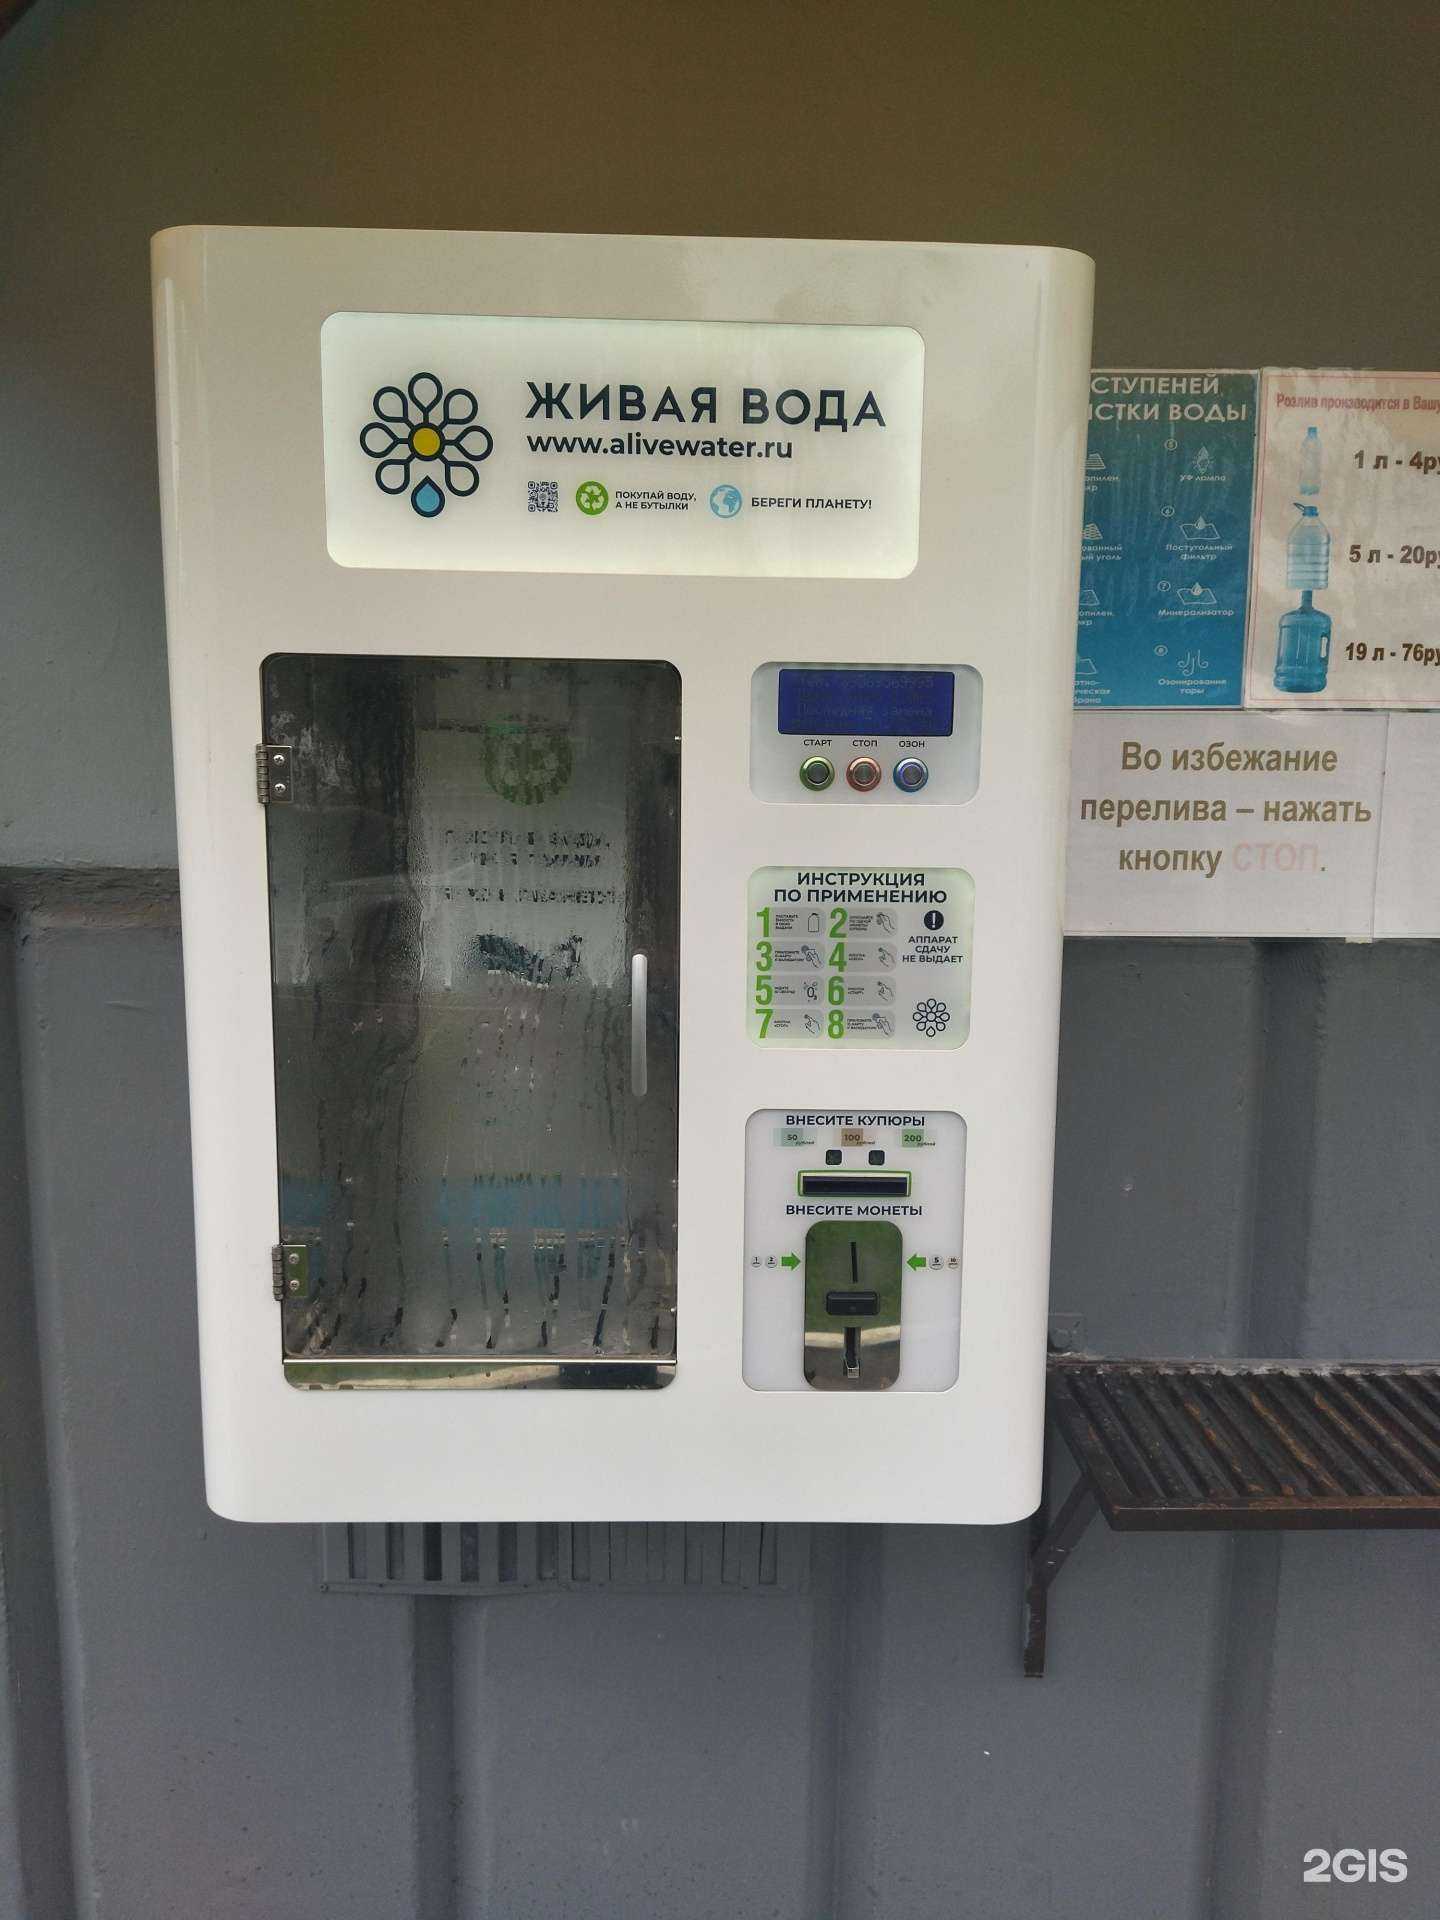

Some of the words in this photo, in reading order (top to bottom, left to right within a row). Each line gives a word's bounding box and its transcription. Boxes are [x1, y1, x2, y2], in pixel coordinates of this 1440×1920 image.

[525, 381, 717, 424] ЖИВАЯ
[742, 387, 886, 432] ВОДА
[1168, 403, 1247, 423] ВОДЫ
[526, 432, 793, 459] www.alivewater.ru
[1354, 449, 1365, 469] 1
[1373, 455, 1388, 469] л
[615, 490, 664, 501] ПОКУПАЙ
[667, 491, 697, 502] ВОДУ,
[615, 501, 623, 509] А
[625, 501, 639, 509] НЕ
[641, 501, 689, 510] БУТЫЛКИ
[751, 496, 801, 508] БЕРЕГИ
[805, 498, 872, 510] ПЛАНЕТУ!
[1349, 544, 1361, 563] 5
[1368, 549, 1381, 563] л
[1346, 642, 1368, 661] 19
[1372, 647, 1385, 661] л
[803, 739, 833, 747] СТАРТ
[852, 739, 878, 748] СТОП
[899, 740, 925, 748] ОЗОН
[1121, 741, 1162, 771] Во
[1172, 741, 1338, 772] избежание
[1081, 798, 1227, 827] перелива
[1263, 800, 1373, 823] нажать
[1119, 848, 1222, 879] кнопку
[798, 871, 925, 888] ИНСТРУКЦИЯ
[774, 889, 802, 902] ПО
[807, 890, 947, 904] ПРИМЕНЕНИЮ
[756, 907, 770, 938] 1
[829, 907, 848, 938] 2
[908, 935, 958, 944] АППАРАТ
[756, 941, 773, 972] 3
[828, 941, 847, 973] 4
[902, 954, 915, 963] НЕ
[917, 955, 963, 964] ВЫДАЕТ
[915, 945, 950, 954] СДАЧУ
[756, 974, 773, 1006] 5
[828, 975, 845, 1006] 6
[755, 1008, 773, 1039] 7
[828, 1009, 845, 1040] 8
[786, 1115, 854, 1126] ВНЕСИТЕ
[857, 1115, 925, 1127] КУПЮРЫ
[787, 1133, 798, 1141] 50
[844, 1133, 861, 1142] 100
[904, 1134, 922, 1142] 200
[786, 1204, 853, 1216] ВНЕСИТЕ
[857, 1205, 923, 1216] МОНЕТЫ
